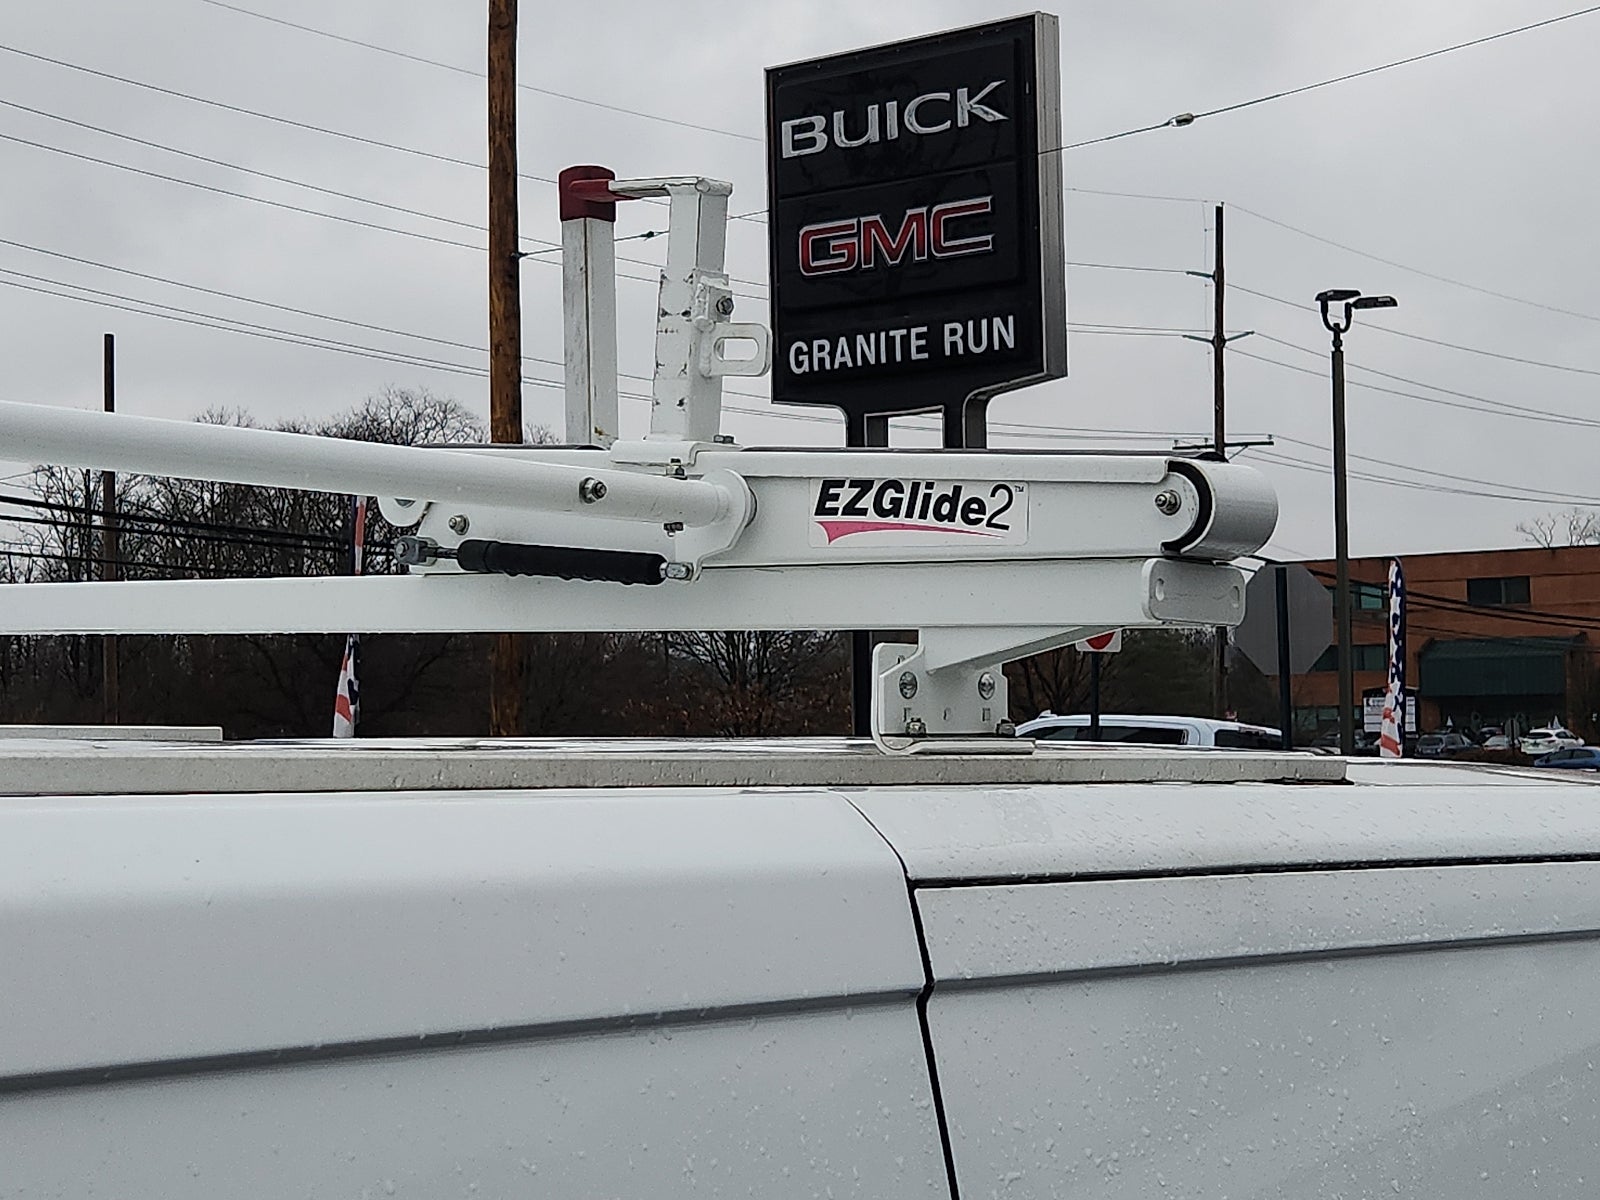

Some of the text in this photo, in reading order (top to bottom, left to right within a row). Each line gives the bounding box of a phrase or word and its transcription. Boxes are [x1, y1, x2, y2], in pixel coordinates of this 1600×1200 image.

[781, 80, 1009, 158] BUICK
[799, 196, 994, 276] GMC
[789, 315, 1016, 374] GRANITE RUN
